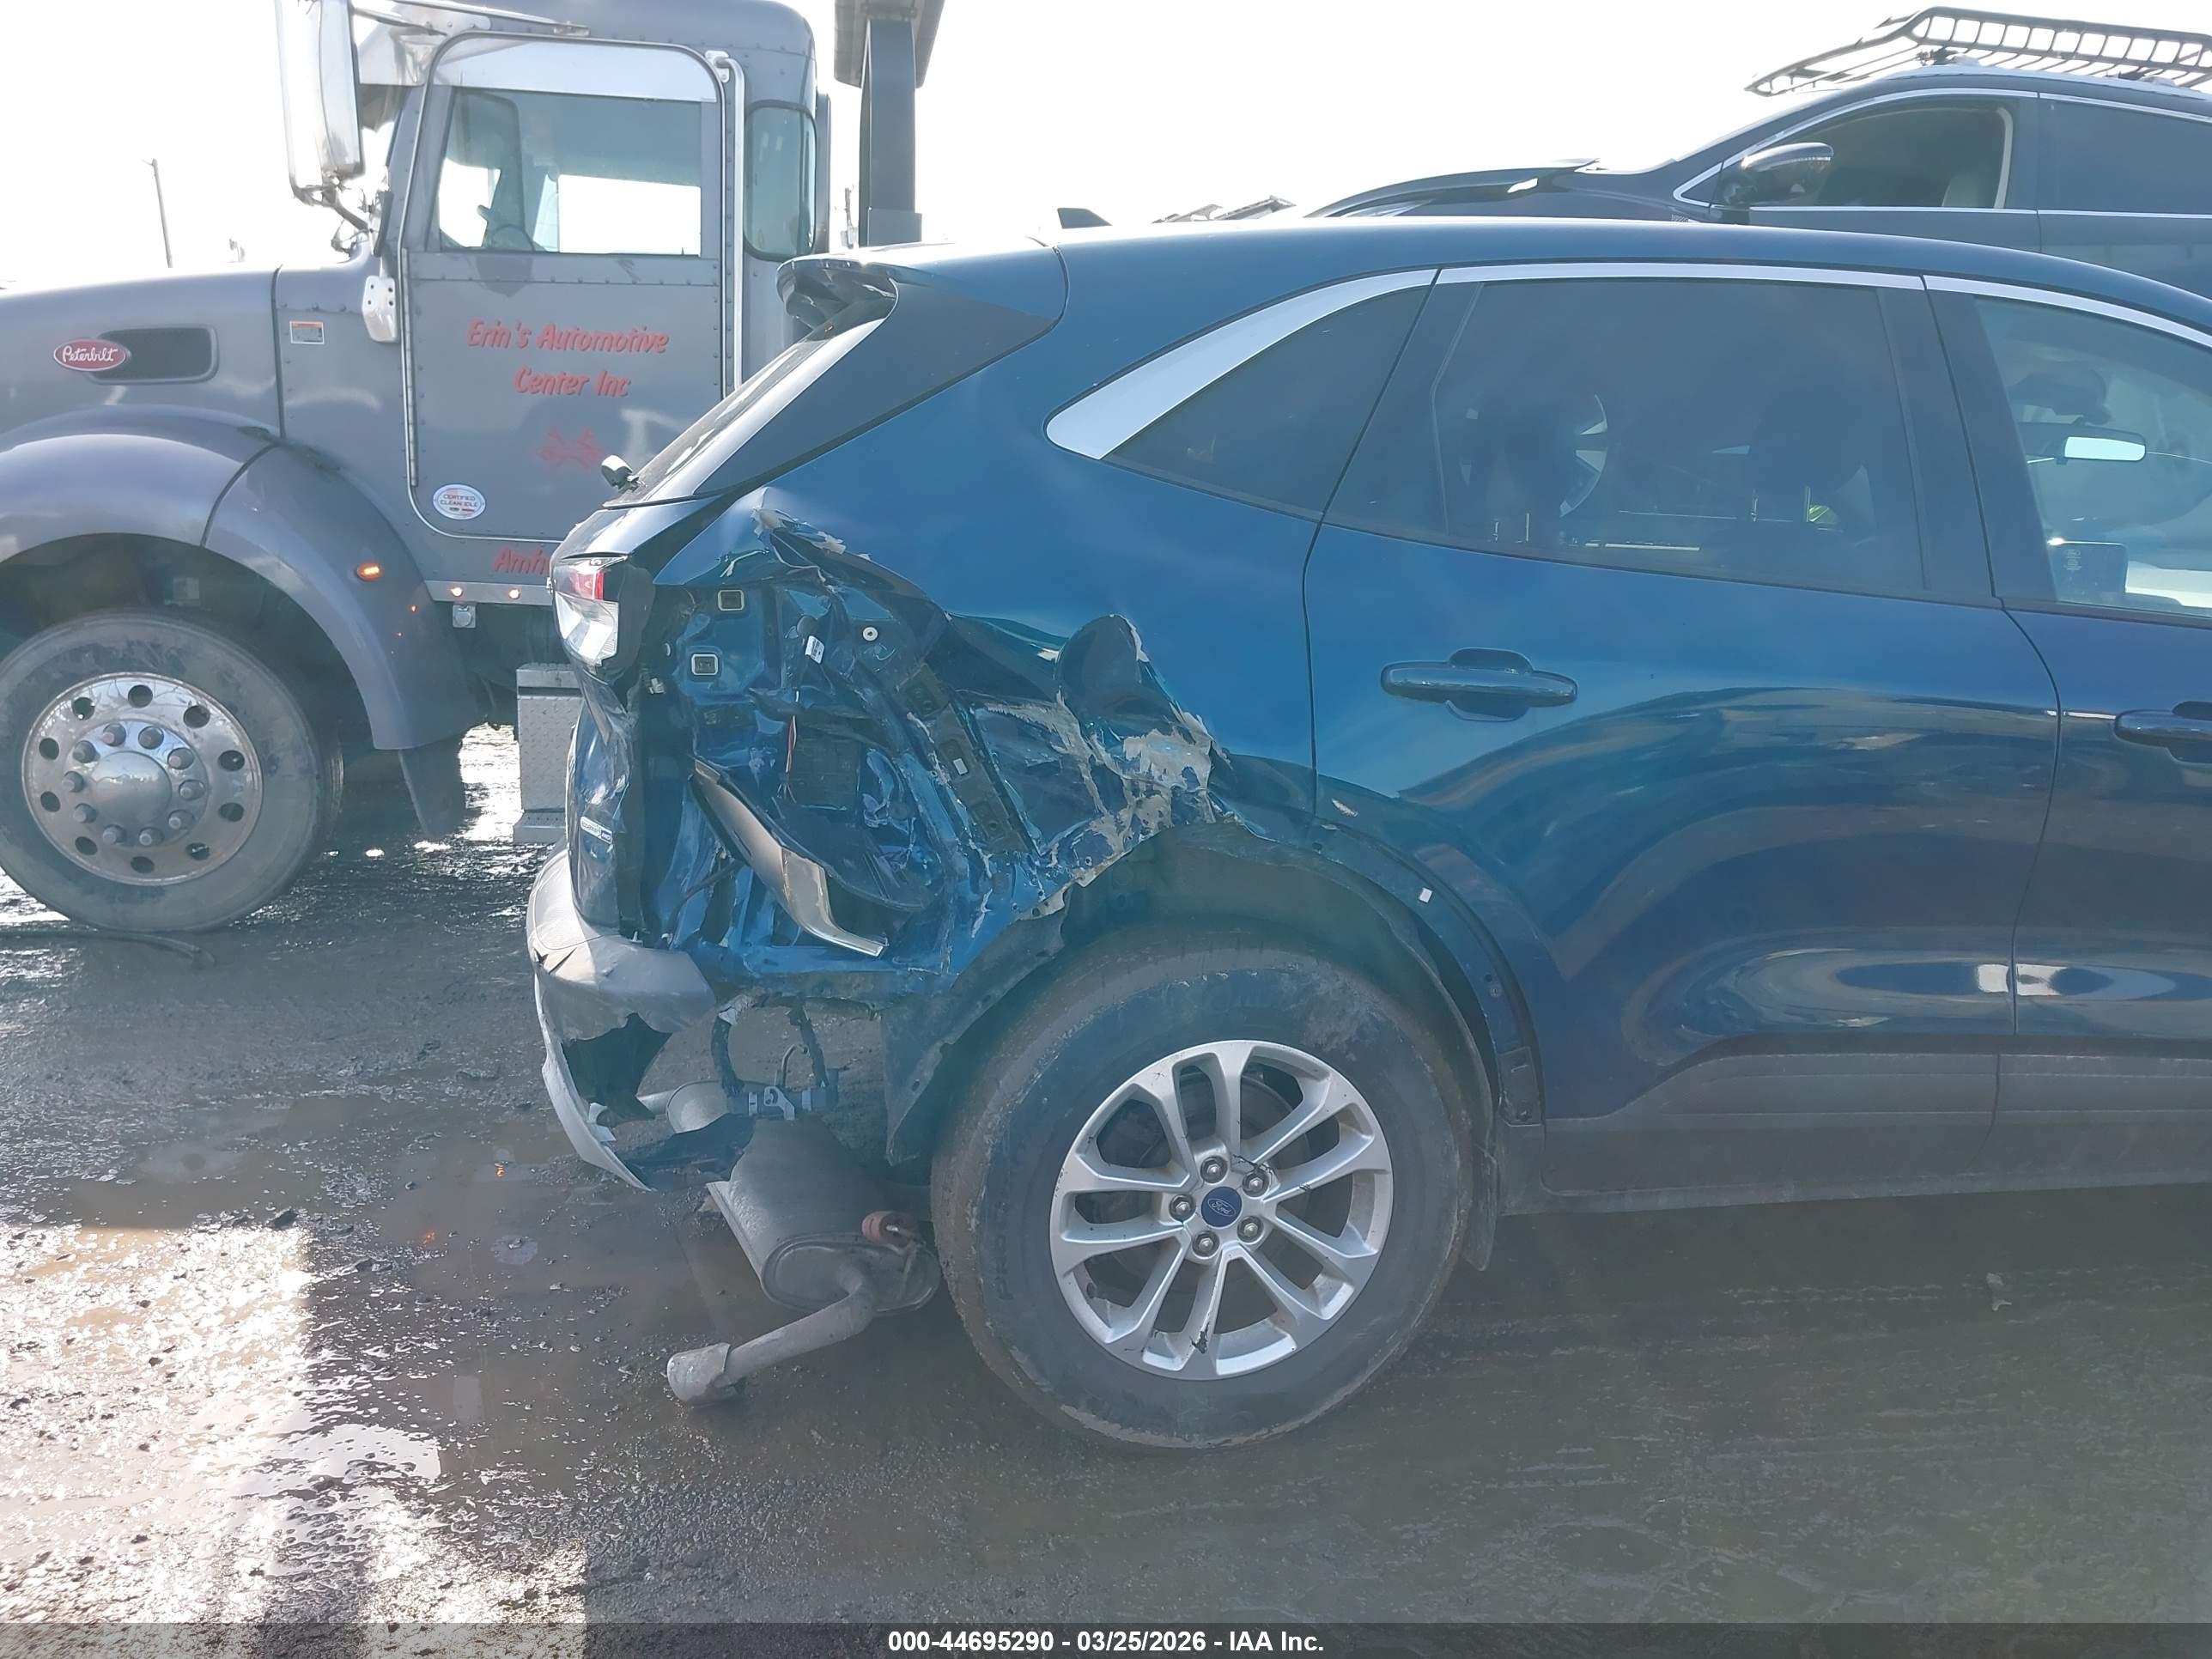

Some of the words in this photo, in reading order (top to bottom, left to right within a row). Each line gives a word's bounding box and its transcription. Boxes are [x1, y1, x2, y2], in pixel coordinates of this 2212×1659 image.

[468, 319, 532, 349] Erin's
[538, 323, 669, 354] Automotive
[62, 345, 118, 362] Peterbilt
[514, 367, 589, 396] Center
[595, 370, 631, 398] Inc
[1212, 1200, 1231, 1215] Ford
